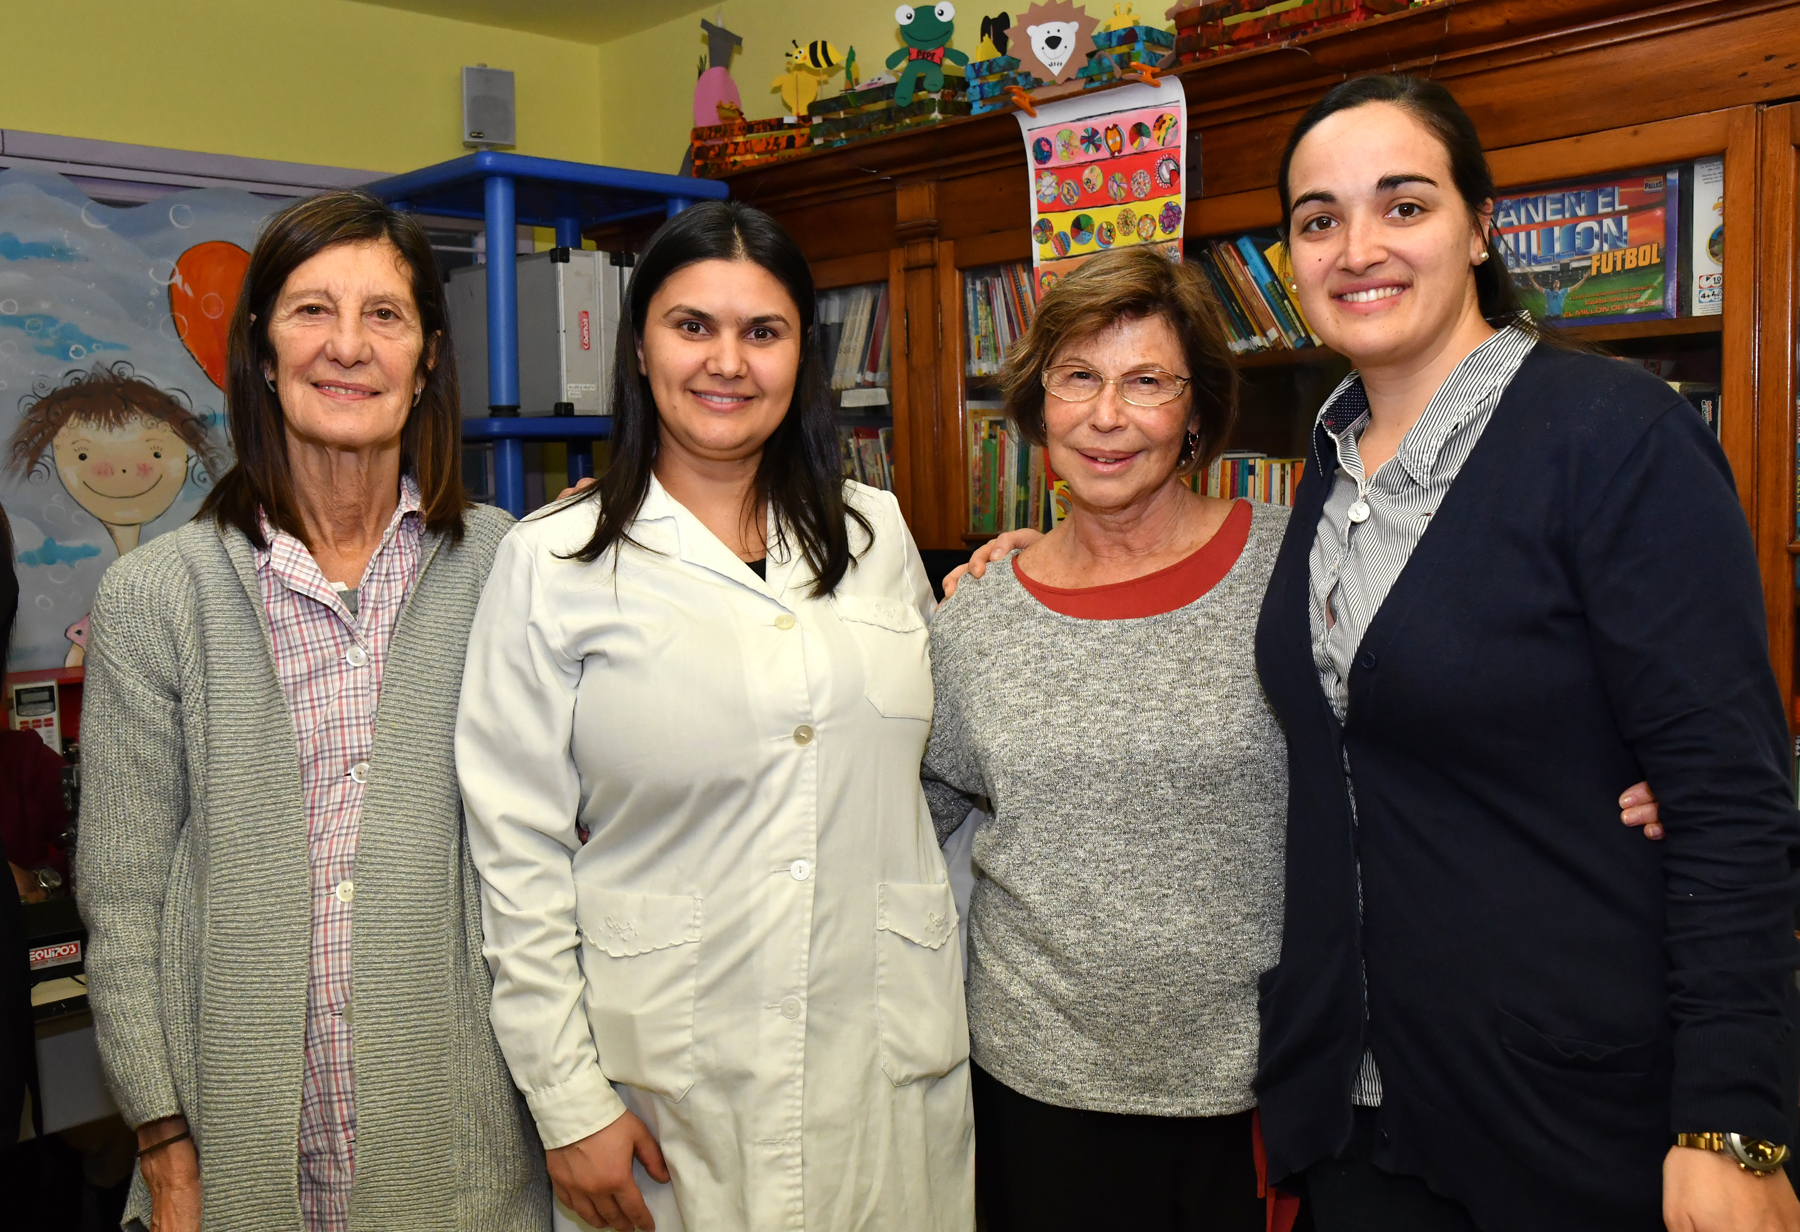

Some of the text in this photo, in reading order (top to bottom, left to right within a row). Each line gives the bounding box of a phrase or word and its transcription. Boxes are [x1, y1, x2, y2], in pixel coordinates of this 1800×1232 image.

[1491, 185, 1629, 228] ANEN EL
[1590, 243, 1661, 276] FUTBOL
[1584, 293, 1641, 306] PARA SALVAR
